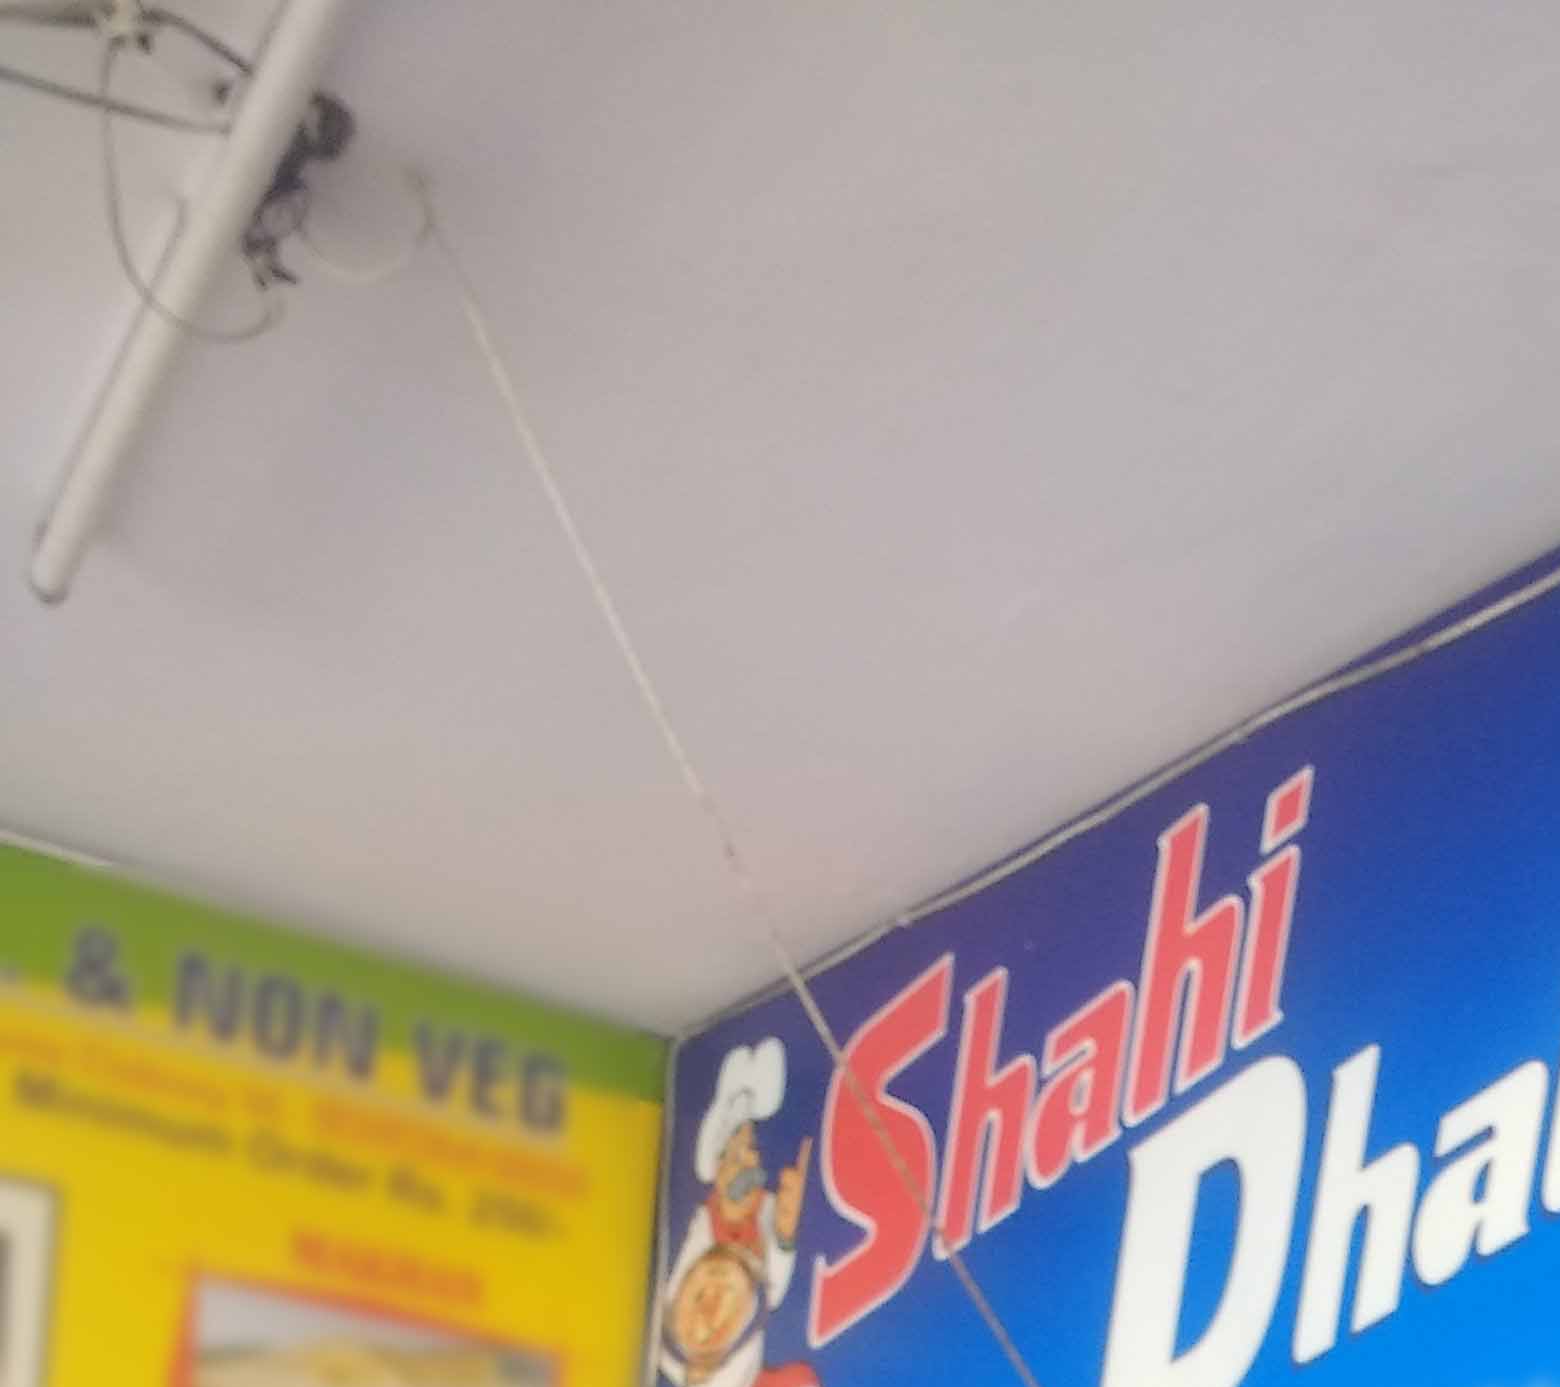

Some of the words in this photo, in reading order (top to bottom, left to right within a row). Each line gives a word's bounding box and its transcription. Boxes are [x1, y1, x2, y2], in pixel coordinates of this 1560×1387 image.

[64, 923, 134, 1012] &
[173, 948, 380, 1083] NON
[411, 1016, 569, 1136] VEG
[807, 765, 1315, 1348] Shahi
